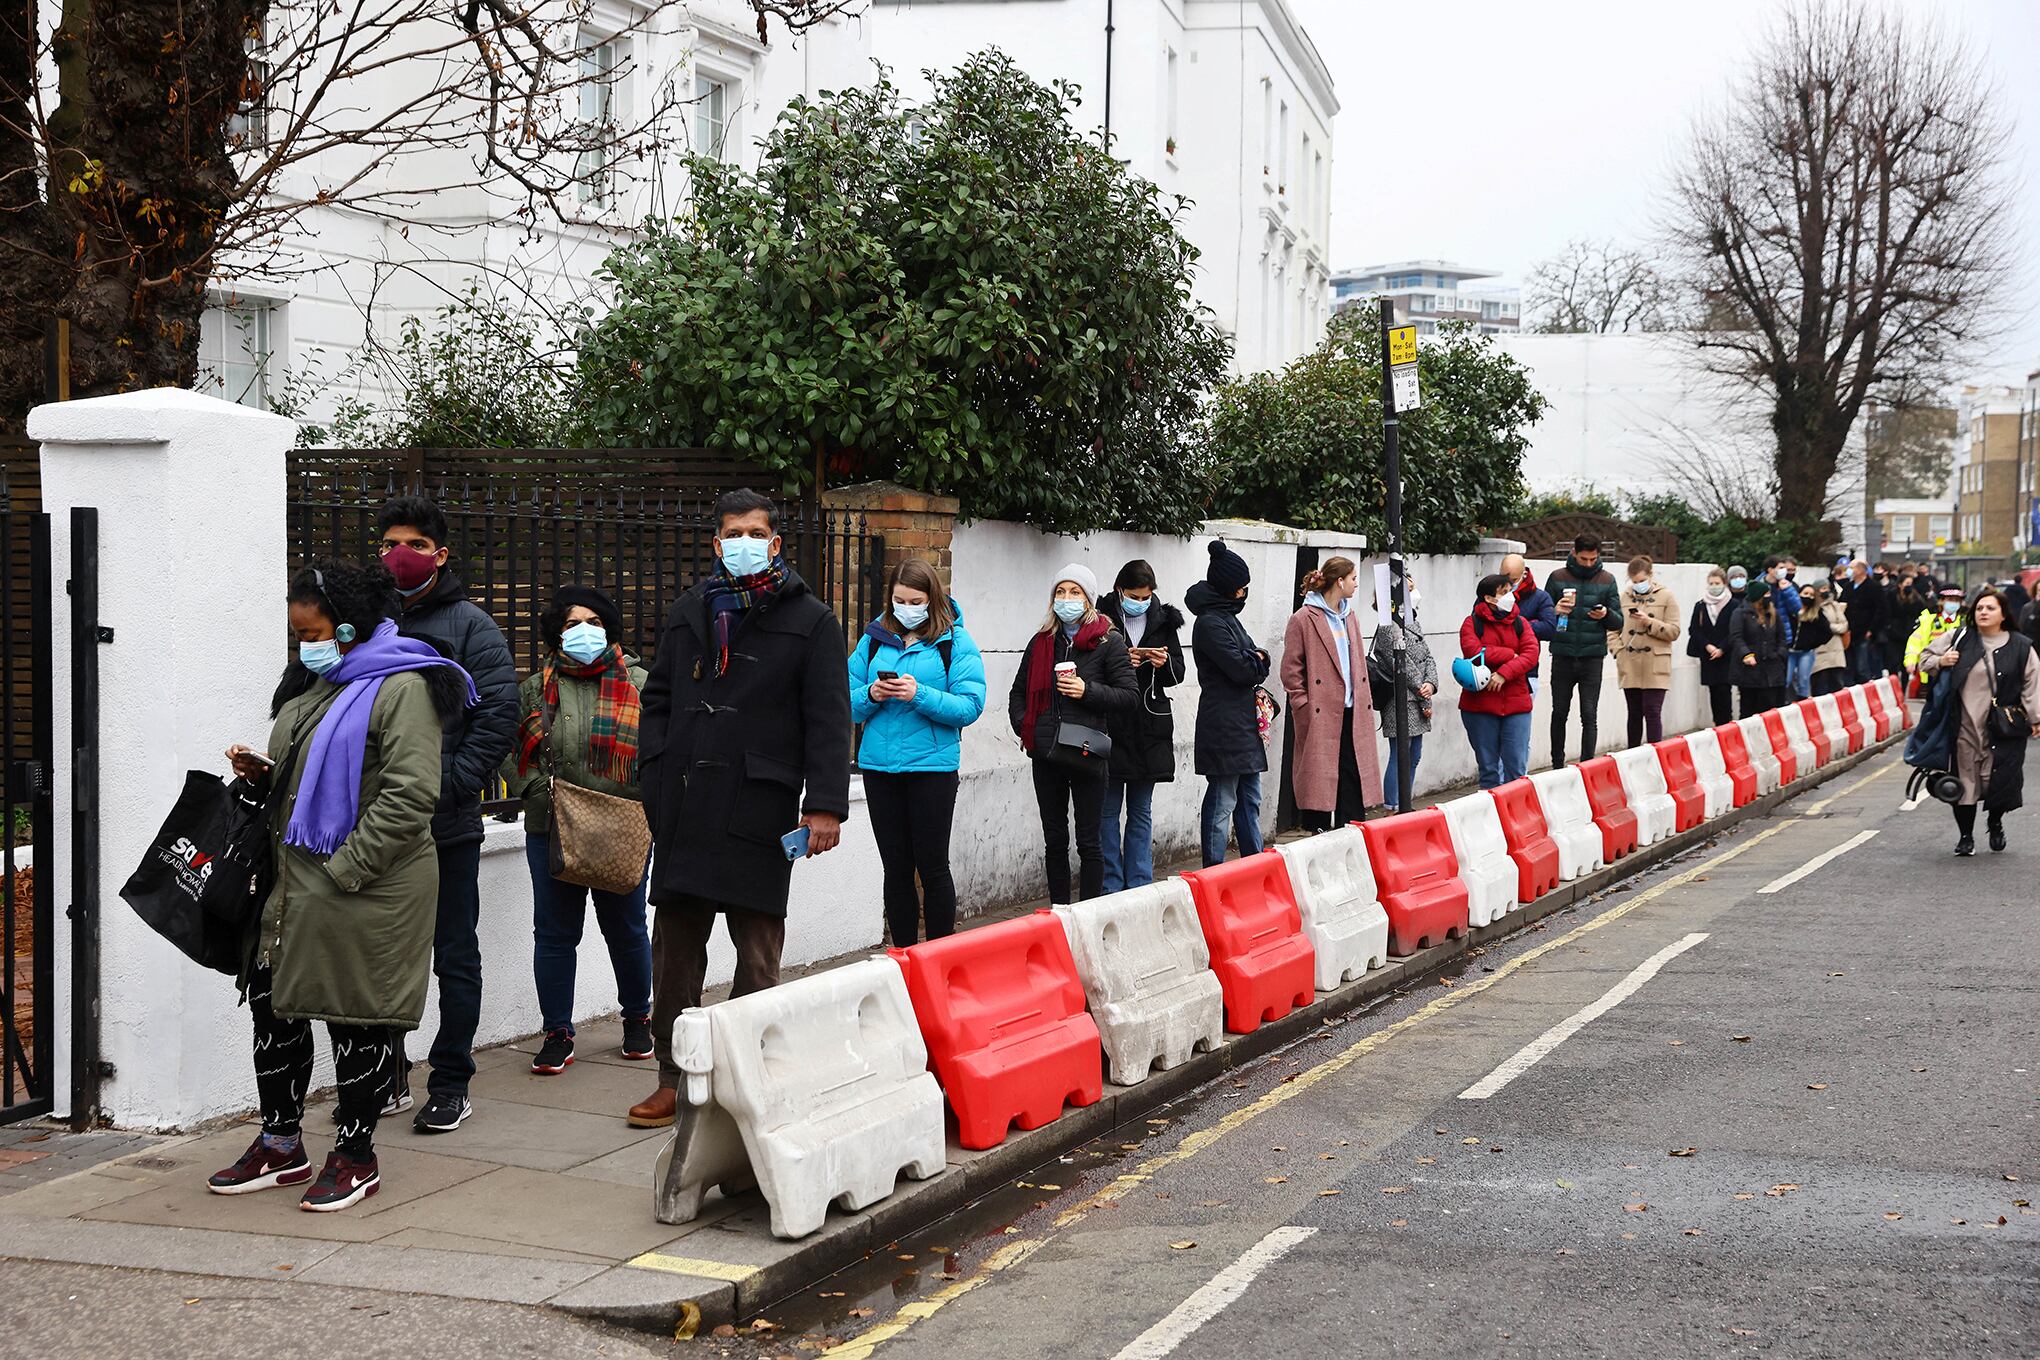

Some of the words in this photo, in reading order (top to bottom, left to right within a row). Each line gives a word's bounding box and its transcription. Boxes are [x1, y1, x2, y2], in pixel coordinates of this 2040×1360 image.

[1392, 343, 1402, 351] Mon
[1405, 341, 1414, 350] Sat
[158, 851, 184, 874] HEALTH
